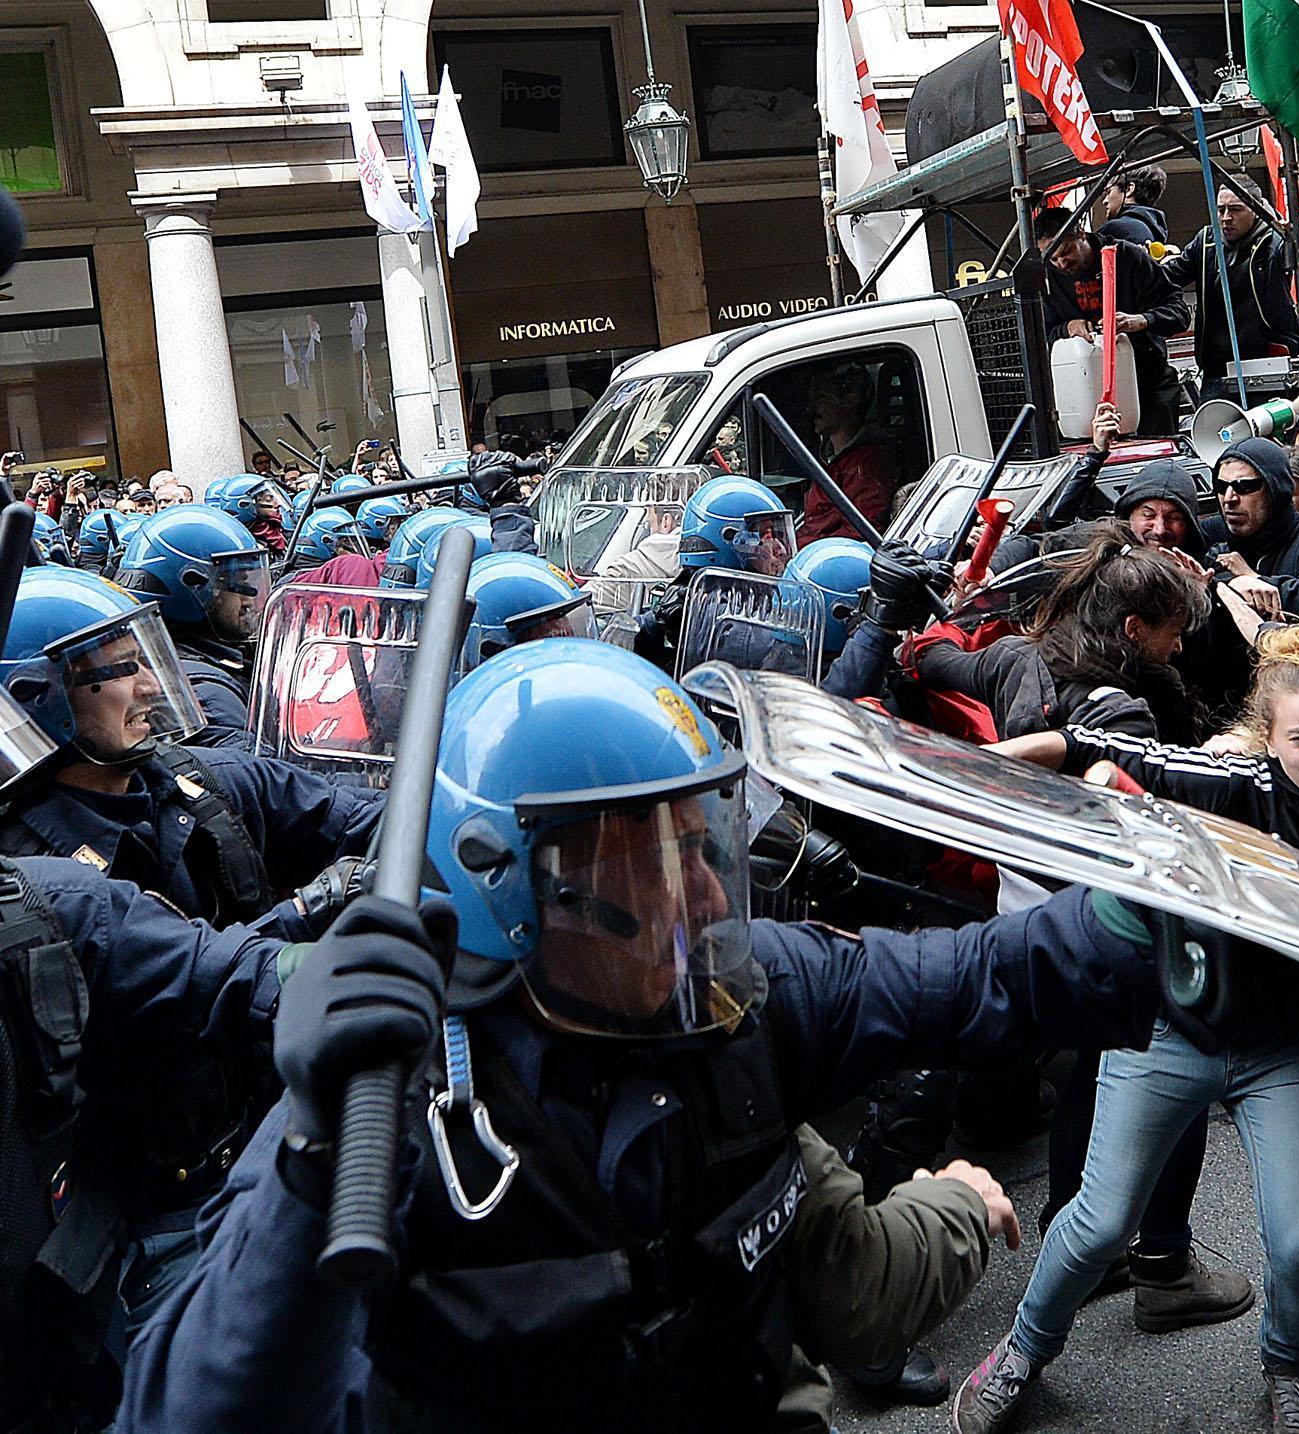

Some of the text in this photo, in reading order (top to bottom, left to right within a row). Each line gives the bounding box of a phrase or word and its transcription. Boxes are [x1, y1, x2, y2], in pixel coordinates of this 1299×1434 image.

[502, 81, 561, 101] fnac
[718, 302, 772, 320] AUDIO
[779, 296, 829, 314] VIDEO
[500, 316, 616, 341] INFORMATICA
